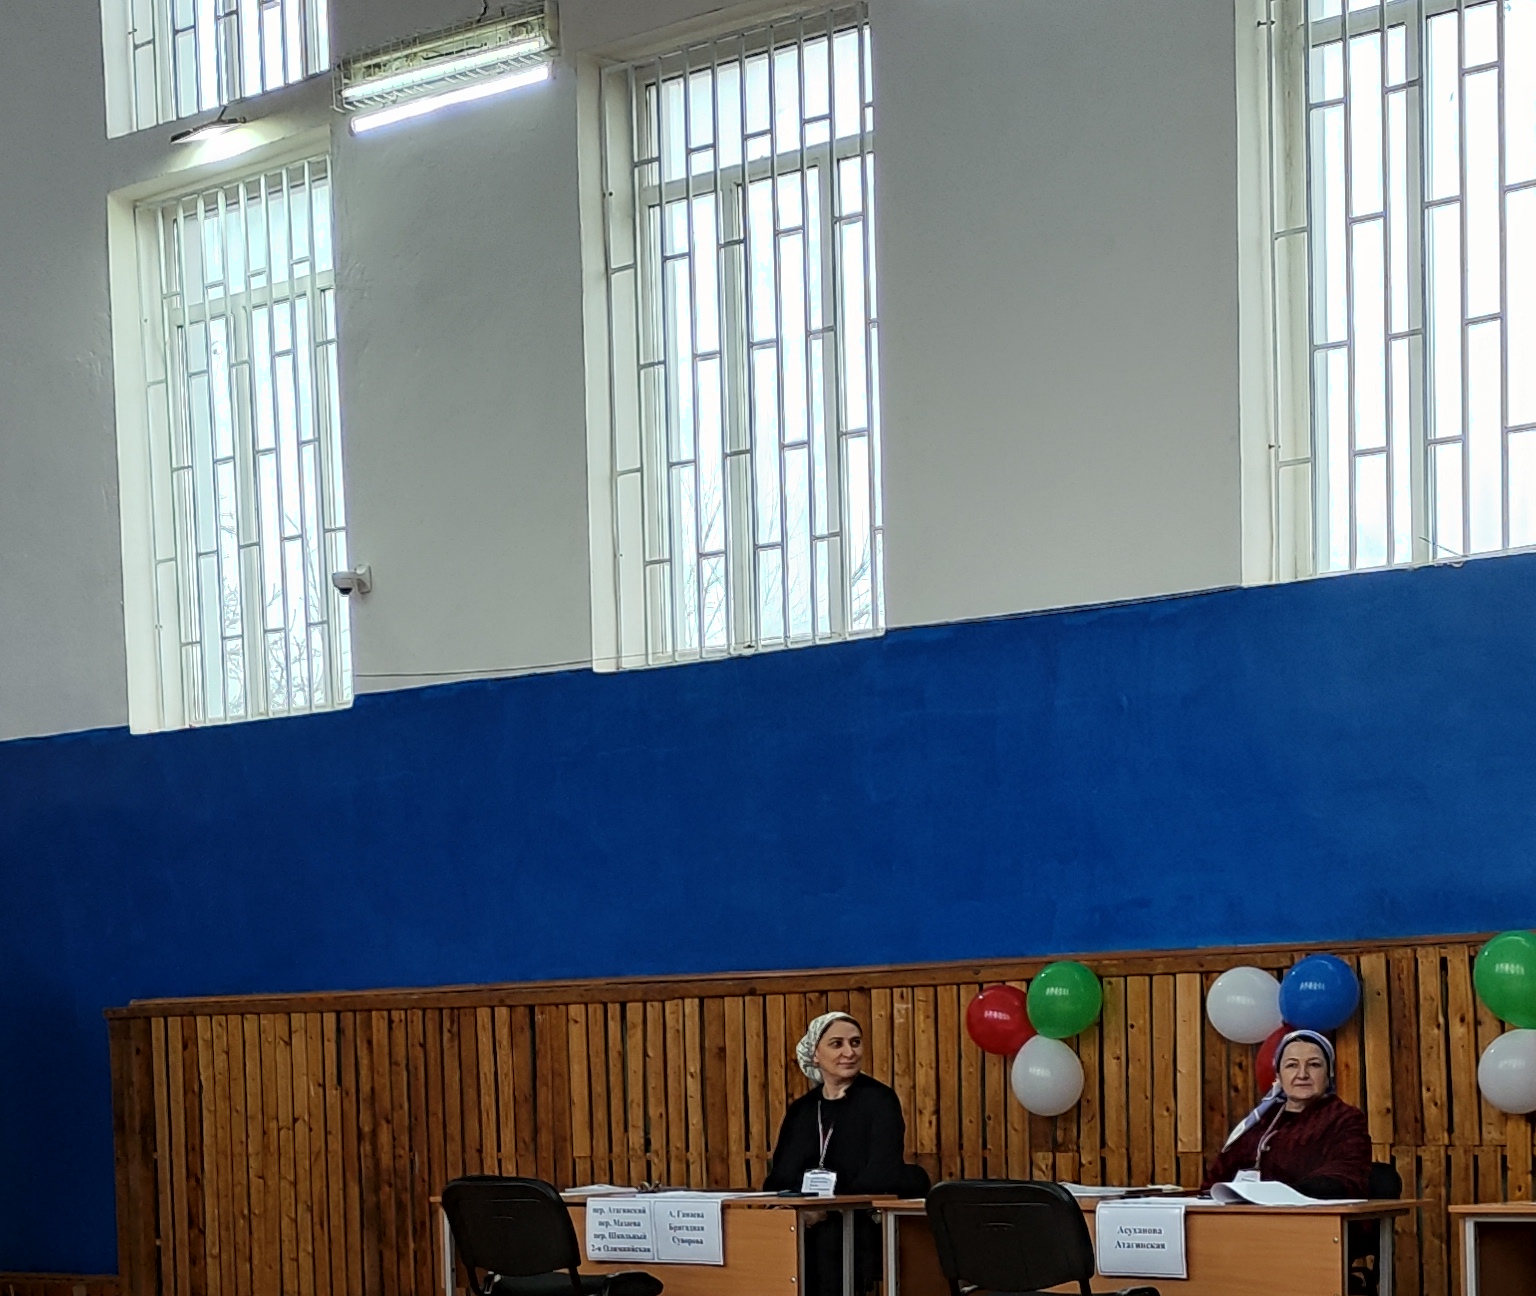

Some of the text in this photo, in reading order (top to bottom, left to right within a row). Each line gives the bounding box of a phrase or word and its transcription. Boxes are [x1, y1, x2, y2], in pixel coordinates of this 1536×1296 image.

[1117, 1226, 1162, 1236] Асуханова
[671, 1235, 704, 1247] Суворова
[1115, 1240, 1166, 1250] Атагинская
